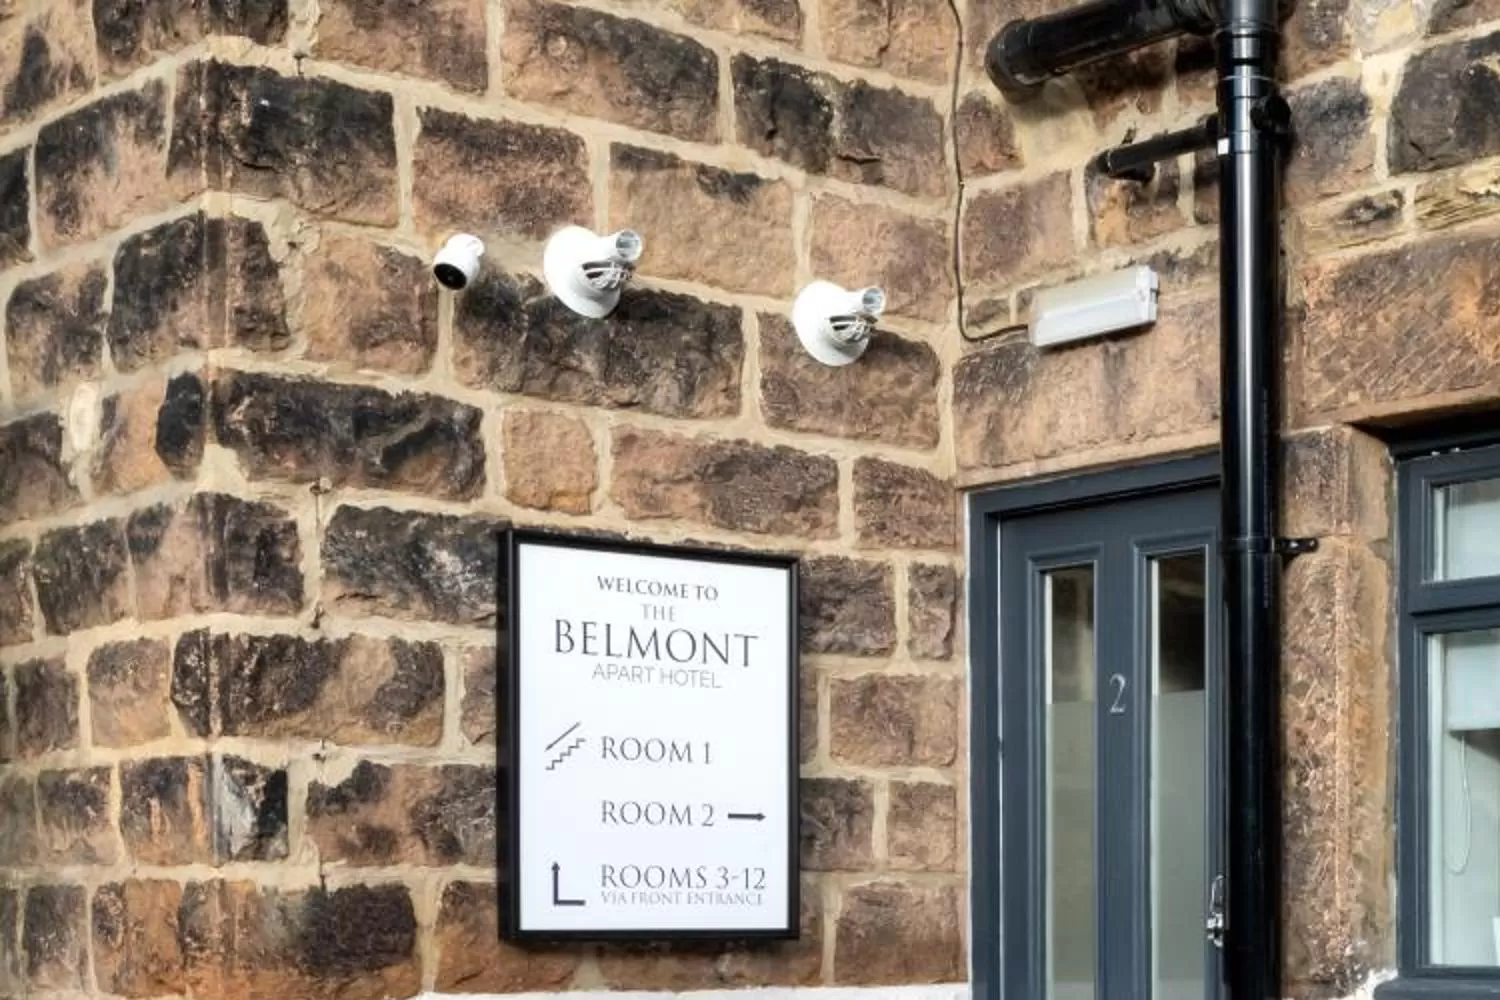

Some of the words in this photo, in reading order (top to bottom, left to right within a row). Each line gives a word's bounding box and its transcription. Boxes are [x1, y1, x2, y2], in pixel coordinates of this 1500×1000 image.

[597, 575, 688, 599] WELCOME
[695, 584, 719, 601] TO
[641, 603, 676, 622] THE
[555, 619, 759, 667] BELMONT
[592, 663, 654, 684] APART
[659, 668, 722, 688] HOTEL
[1110, 673, 1126, 713] 2
[600, 735, 693, 763] ROOM
[600, 800, 693, 827] ROOM
[701, 803, 715, 827] 2
[600, 864, 707, 889] ROOMS
[716, 866, 766, 890] 3-12
[600, 891, 627, 906] VIA
[631, 891, 684, 906] FRONT
[687, 891, 763, 907] ENTRANCE
